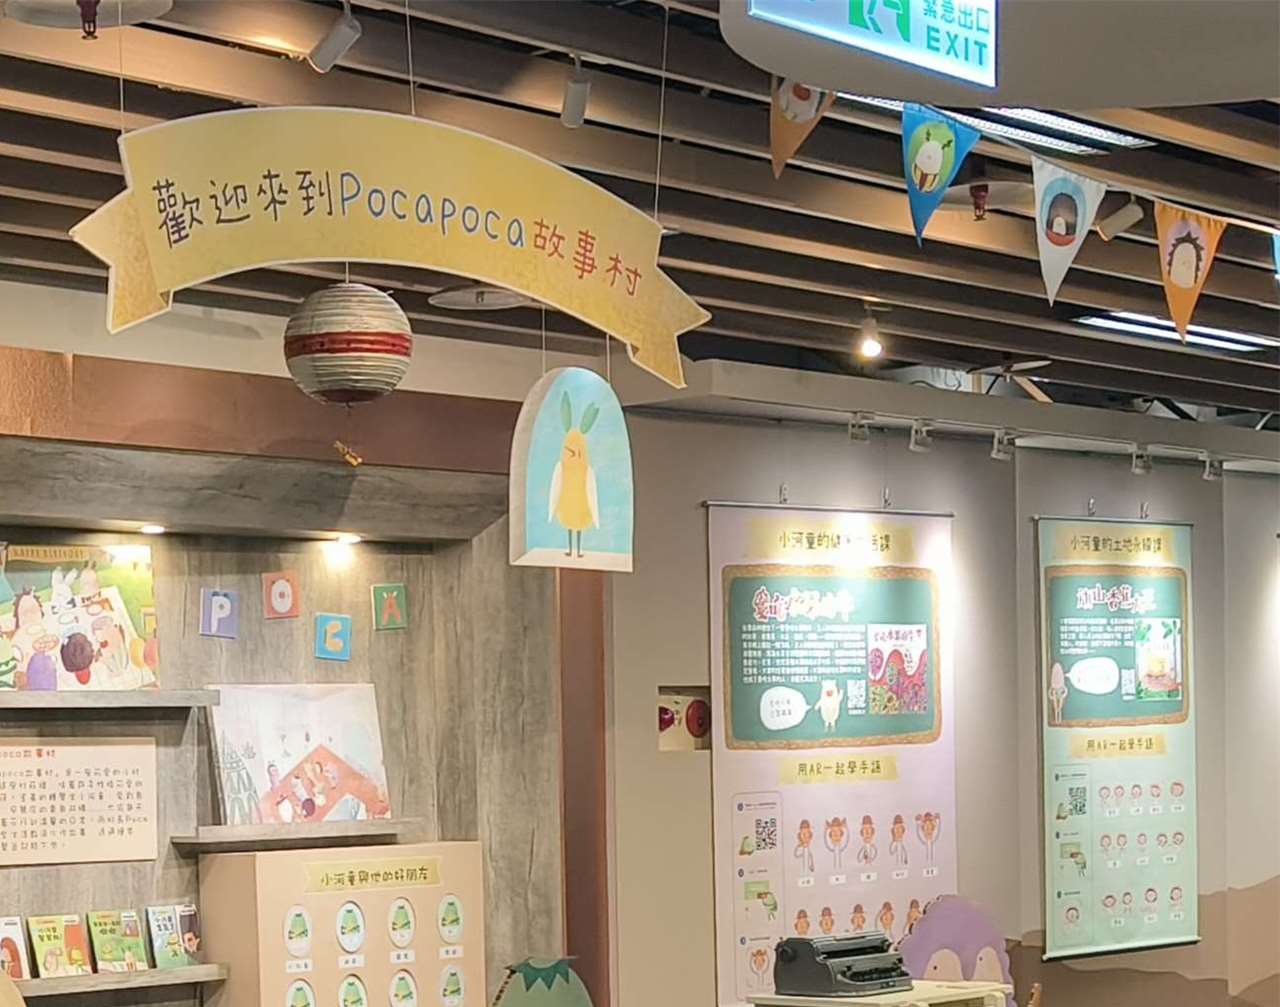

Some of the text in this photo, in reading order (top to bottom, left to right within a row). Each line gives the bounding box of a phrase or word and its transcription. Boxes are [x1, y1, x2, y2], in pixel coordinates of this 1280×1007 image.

[926, 24, 988, 66] EXIT
[152, 168, 643, 297] 歡迎來到Pocapoca故事村
[320, 867, 429, 887] 小河童與他的好朋友
